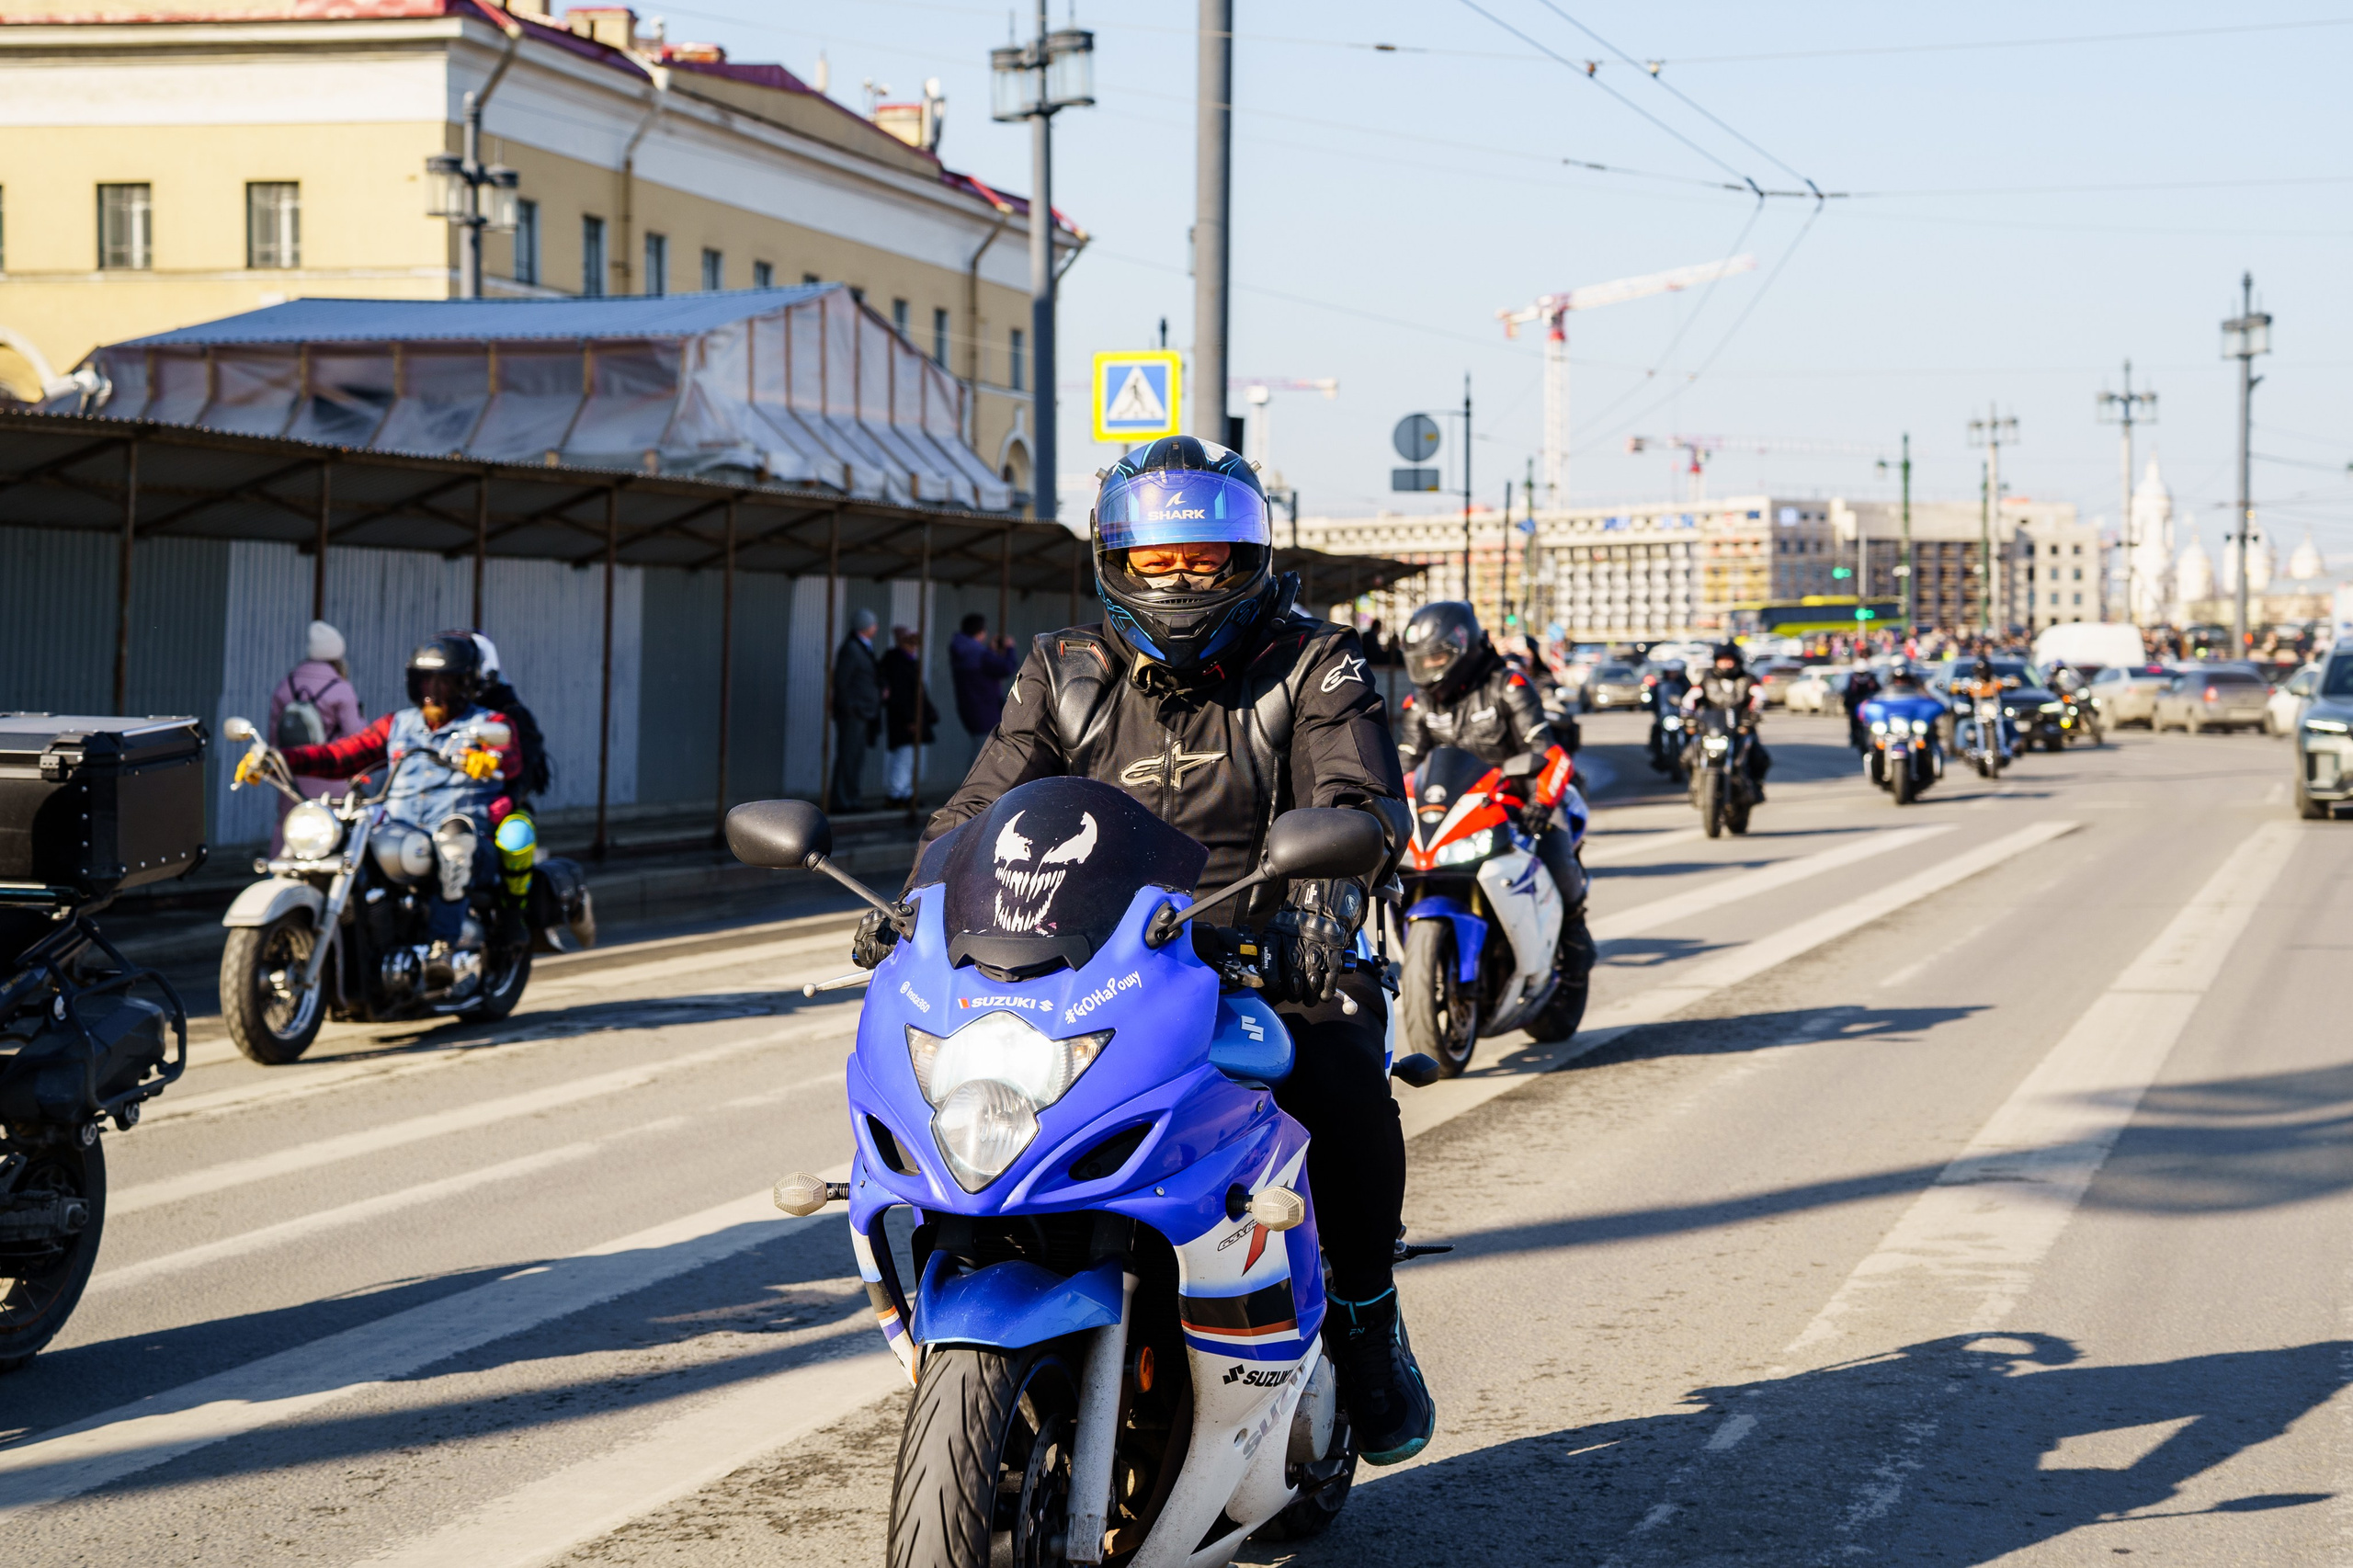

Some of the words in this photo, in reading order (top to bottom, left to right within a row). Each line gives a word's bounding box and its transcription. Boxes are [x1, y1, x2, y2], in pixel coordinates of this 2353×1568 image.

[1148, 509, 1205, 520] SHARK
[906, 987, 930, 1013] Insta360
[971, 995, 1037, 1009] SUZUKI
